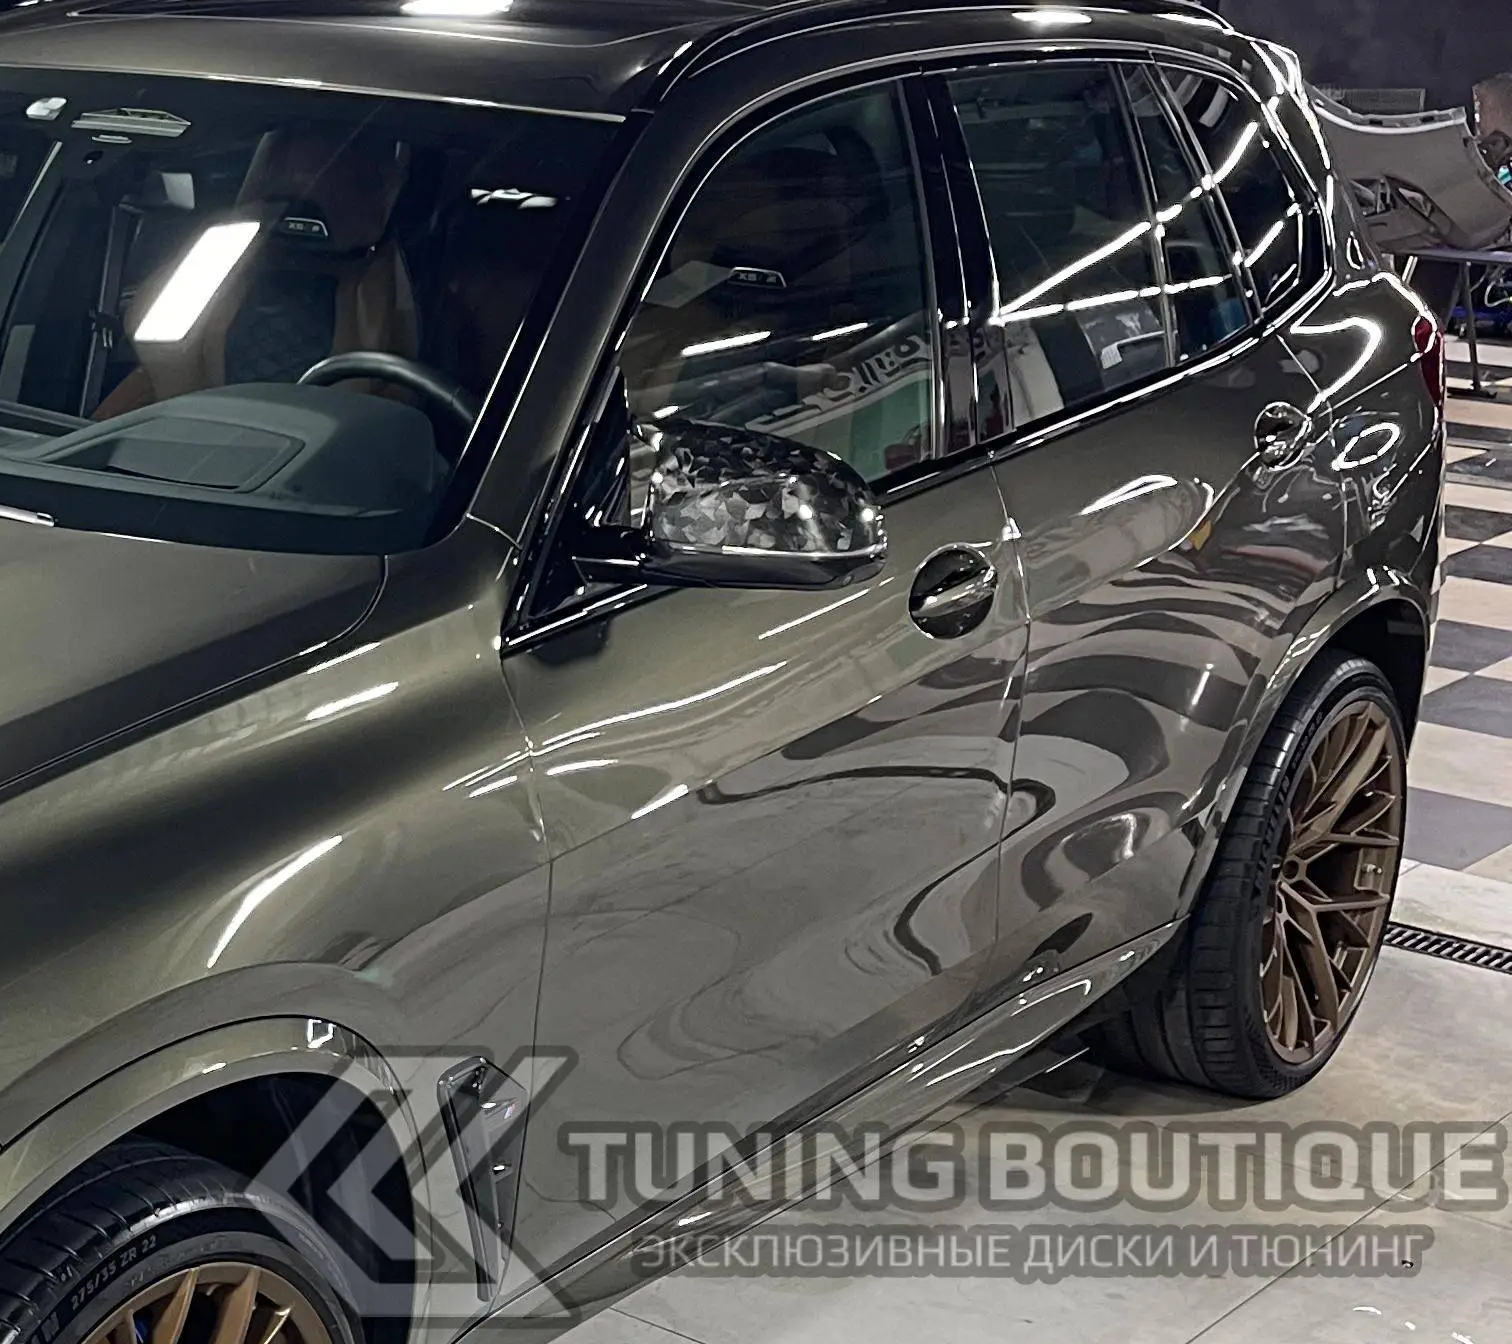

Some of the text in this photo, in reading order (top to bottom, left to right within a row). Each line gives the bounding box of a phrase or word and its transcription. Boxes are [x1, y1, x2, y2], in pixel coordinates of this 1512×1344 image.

[70, 1259, 117, 1311] 275/35
[119, 1246, 138, 1266] ZR
[141, 1234, 158, 1254] 22
